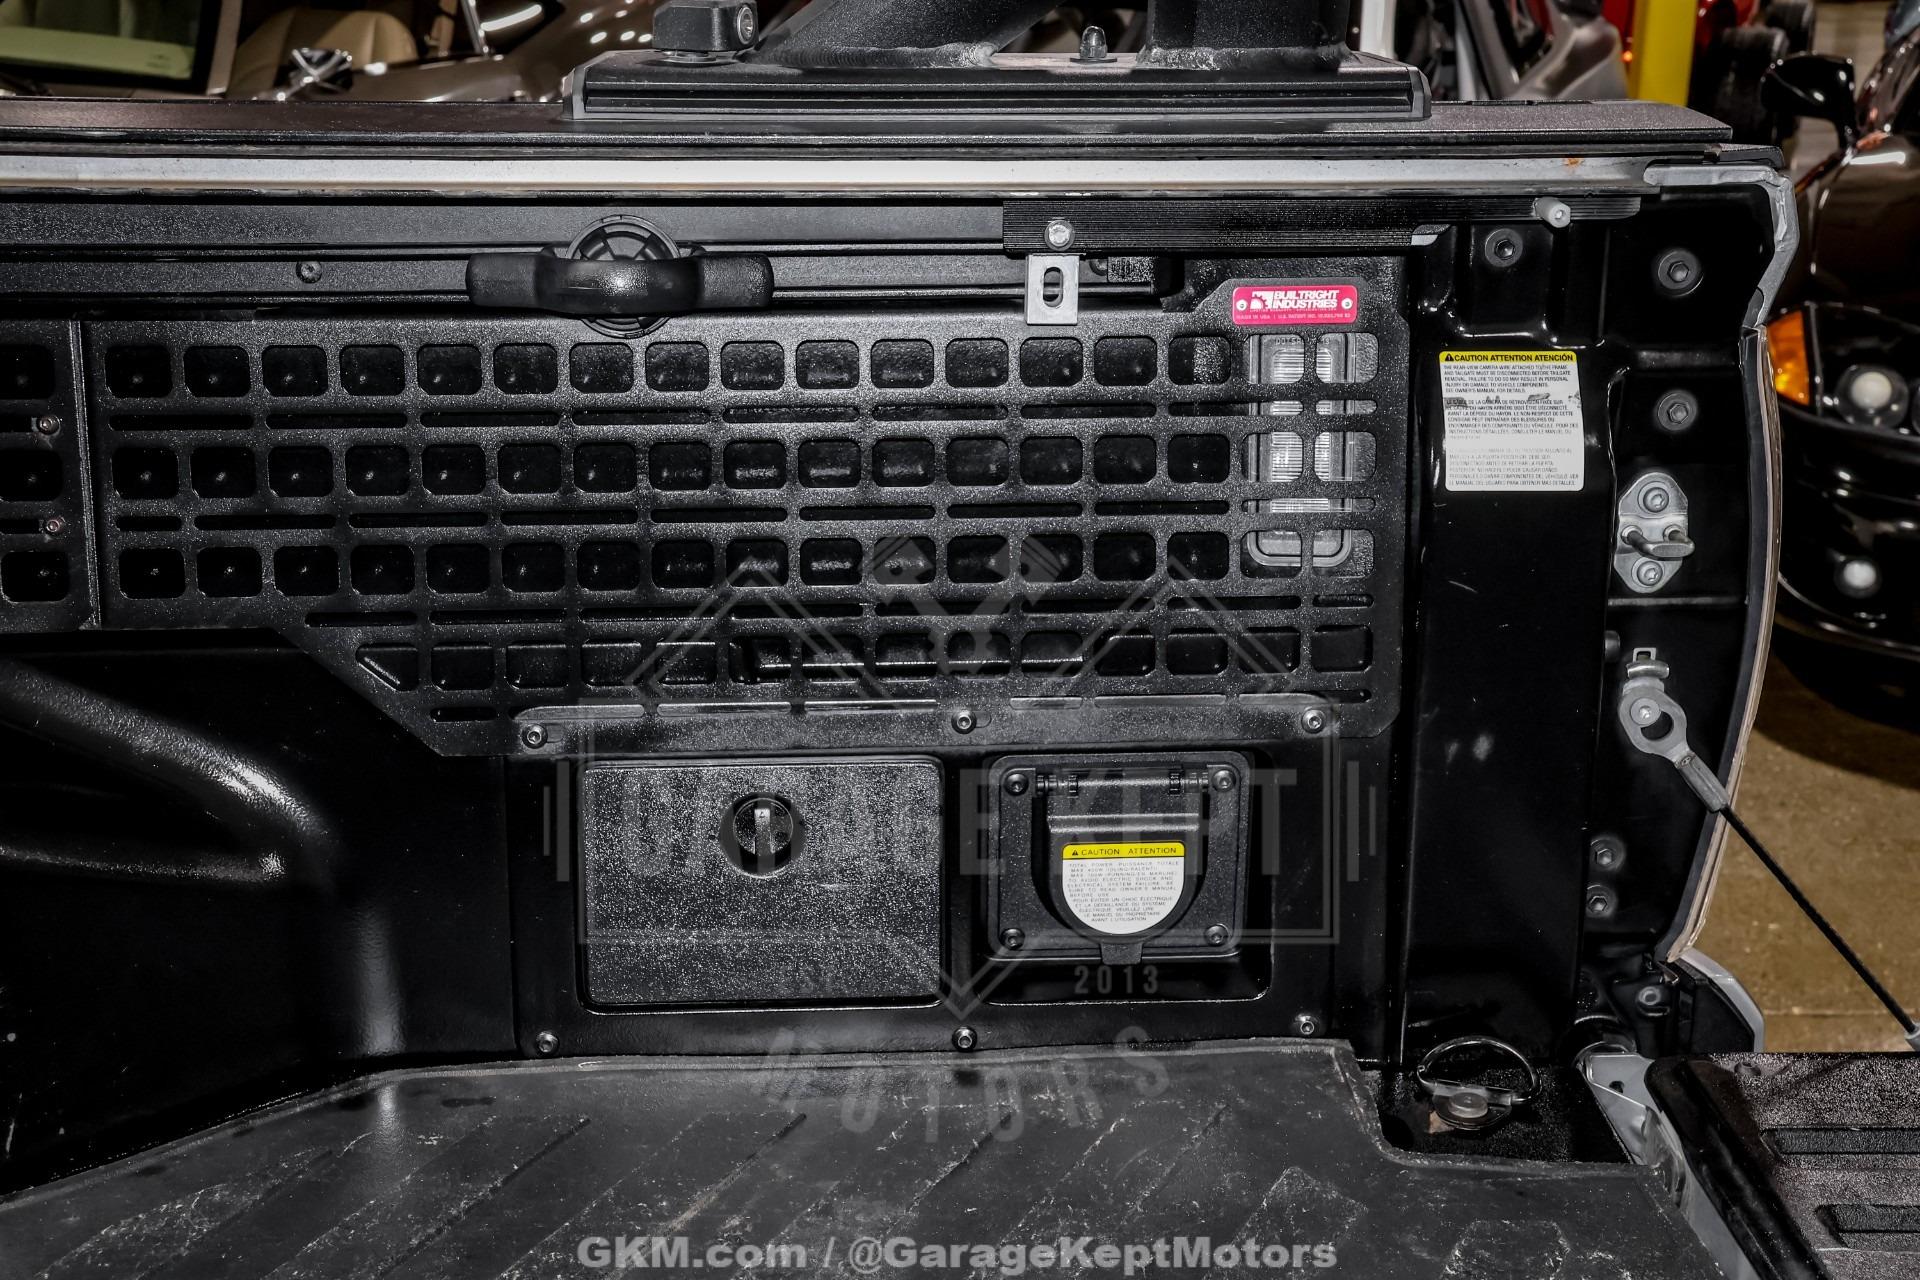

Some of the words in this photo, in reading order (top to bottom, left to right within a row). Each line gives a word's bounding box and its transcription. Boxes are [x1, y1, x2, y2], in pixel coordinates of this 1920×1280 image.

[1274, 290, 1339, 300] BUILTRIGHT
[1273, 299, 1337, 309] INDUSTRIES
[1454, 354, 1489, 362] CAUTION
[1490, 354, 1533, 362] ATTENTION
[1534, 352, 1574, 361] ATENCIÓN
[1081, 848, 1120, 856] CAUTION
[1128, 847, 1176, 855] ATTENTION
